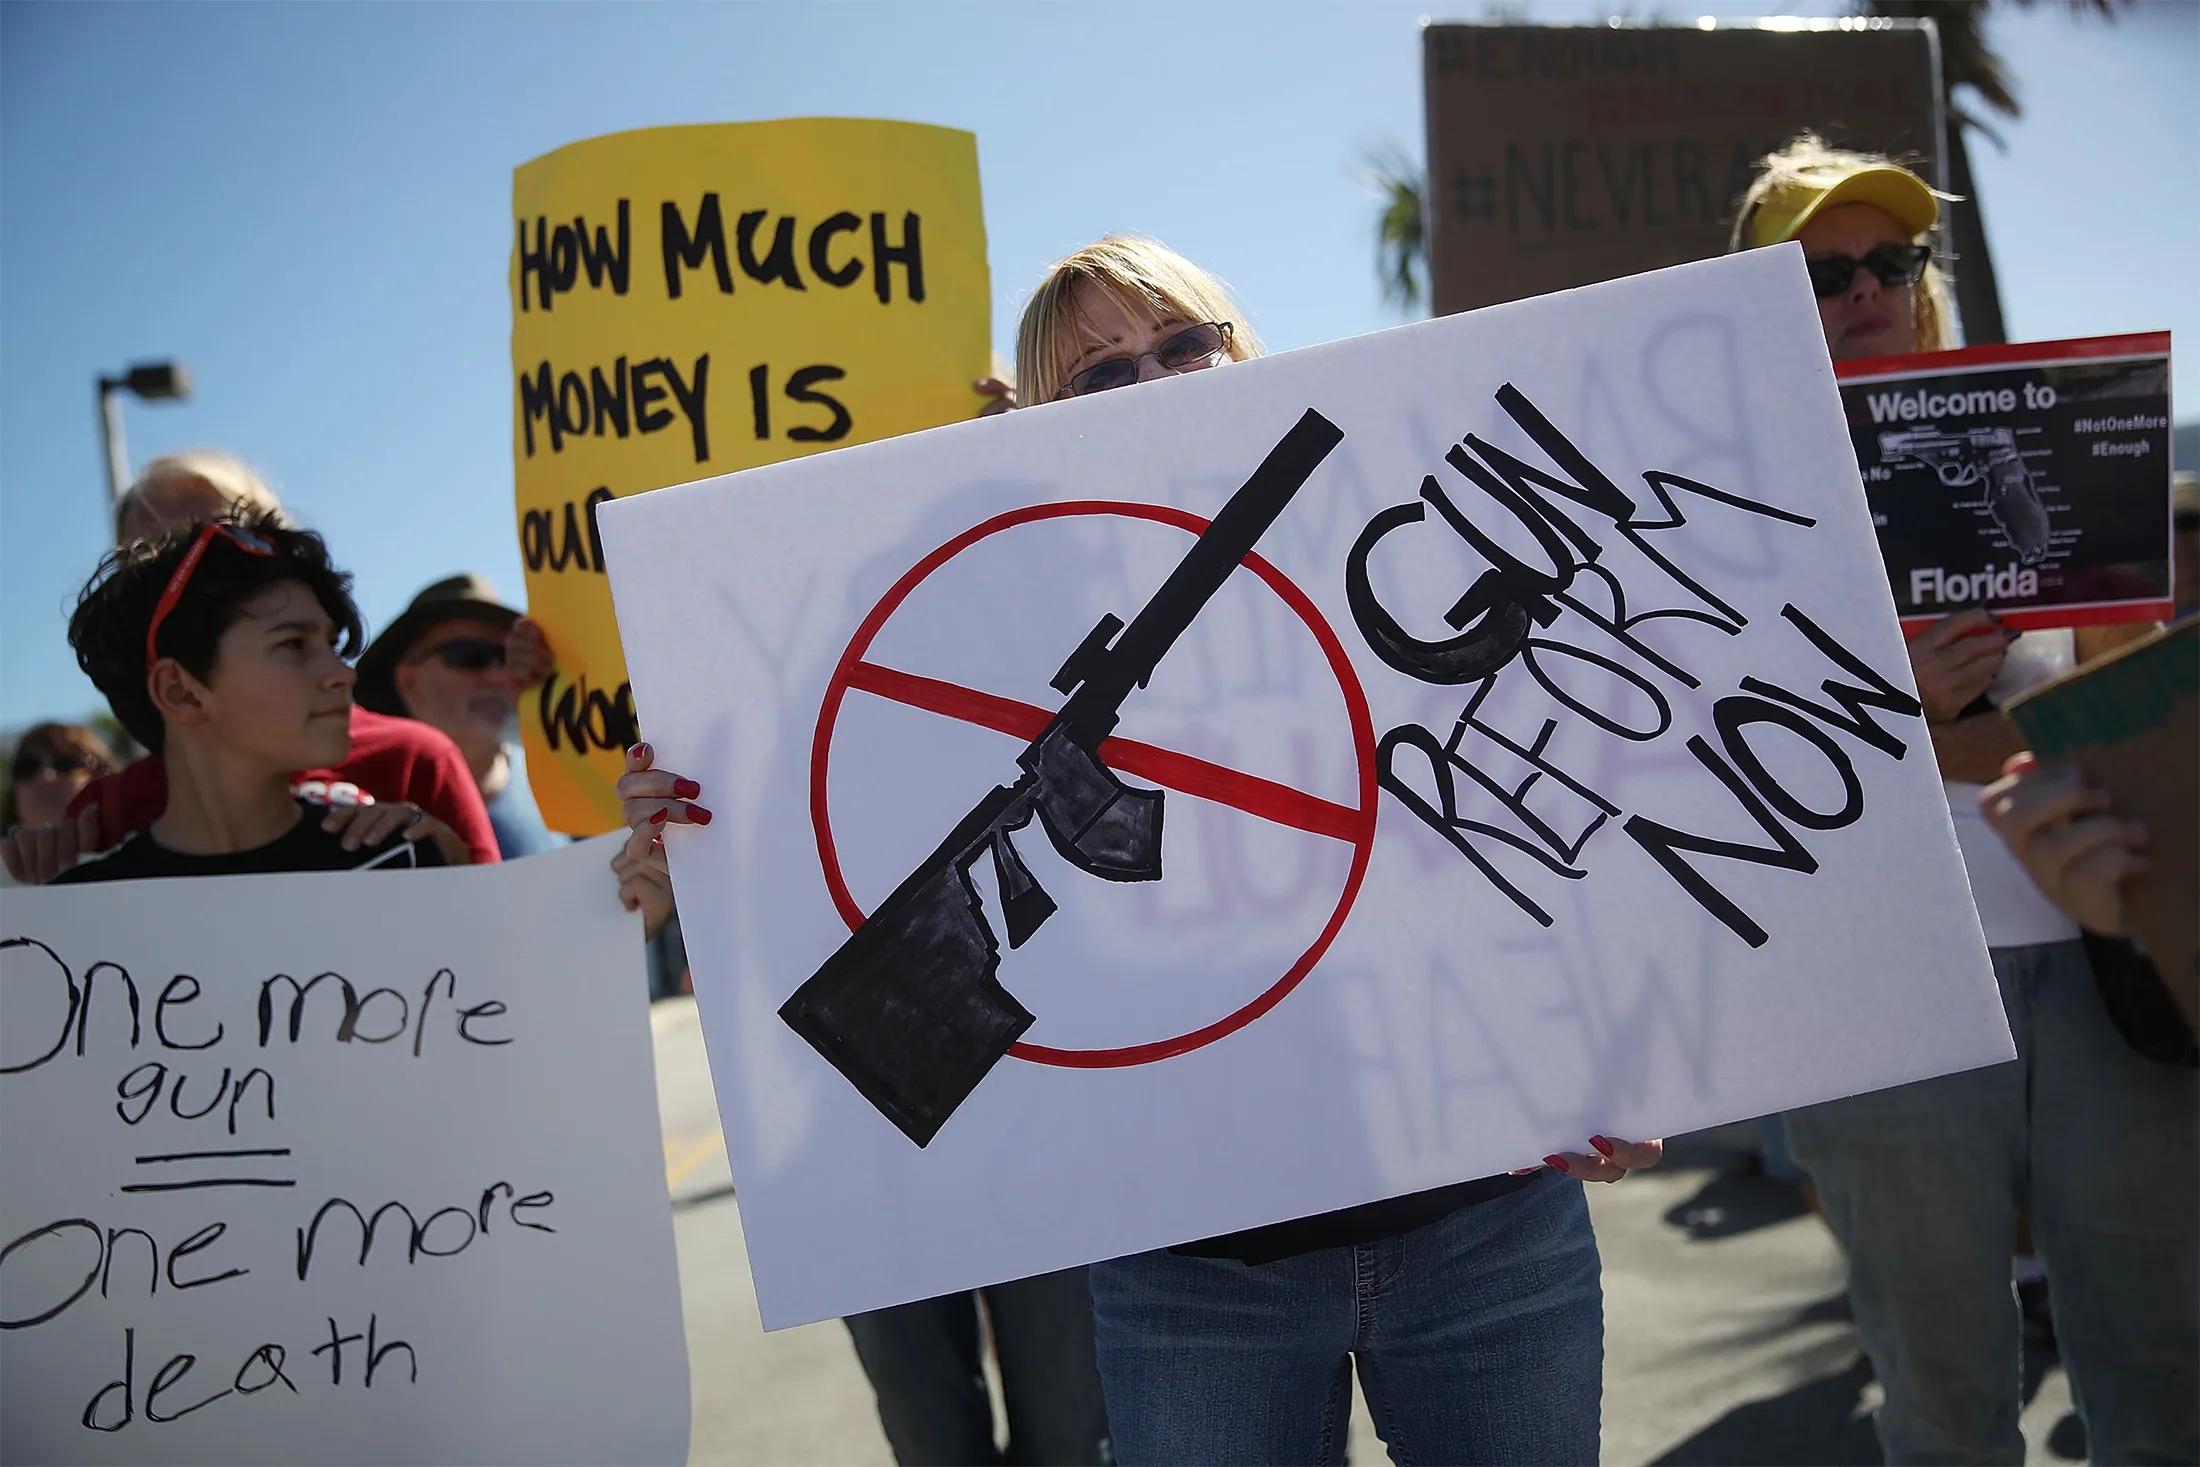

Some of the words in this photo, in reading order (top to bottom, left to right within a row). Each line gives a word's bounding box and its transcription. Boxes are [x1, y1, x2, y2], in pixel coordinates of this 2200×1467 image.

[1452, 138, 1765, 234] #NEVERA
[520, 197, 631, 312] HOW
[520, 353, 710, 464] MONEY
[750, 363, 855, 443] IS
[1867, 389, 2016, 424] Welcome
[2023, 381, 2058, 411] to
[2074, 414, 2167, 434] #NotOneMore
[2092, 438, 2150, 458] #Enough
[1345, 381, 1636, 685] GUN
[1910, 562, 2039, 605] Florida
[1375, 469, 1818, 928] REFORM
[1622, 602, 1923, 949] NOW
[0, 936, 224, 1074] One
[259, 967, 515, 1057] more
[116, 1062, 276, 1135] gun
[0, 1217, 251, 1331] One
[297, 1181, 558, 1283] more
[81, 1312, 419, 1433] death
